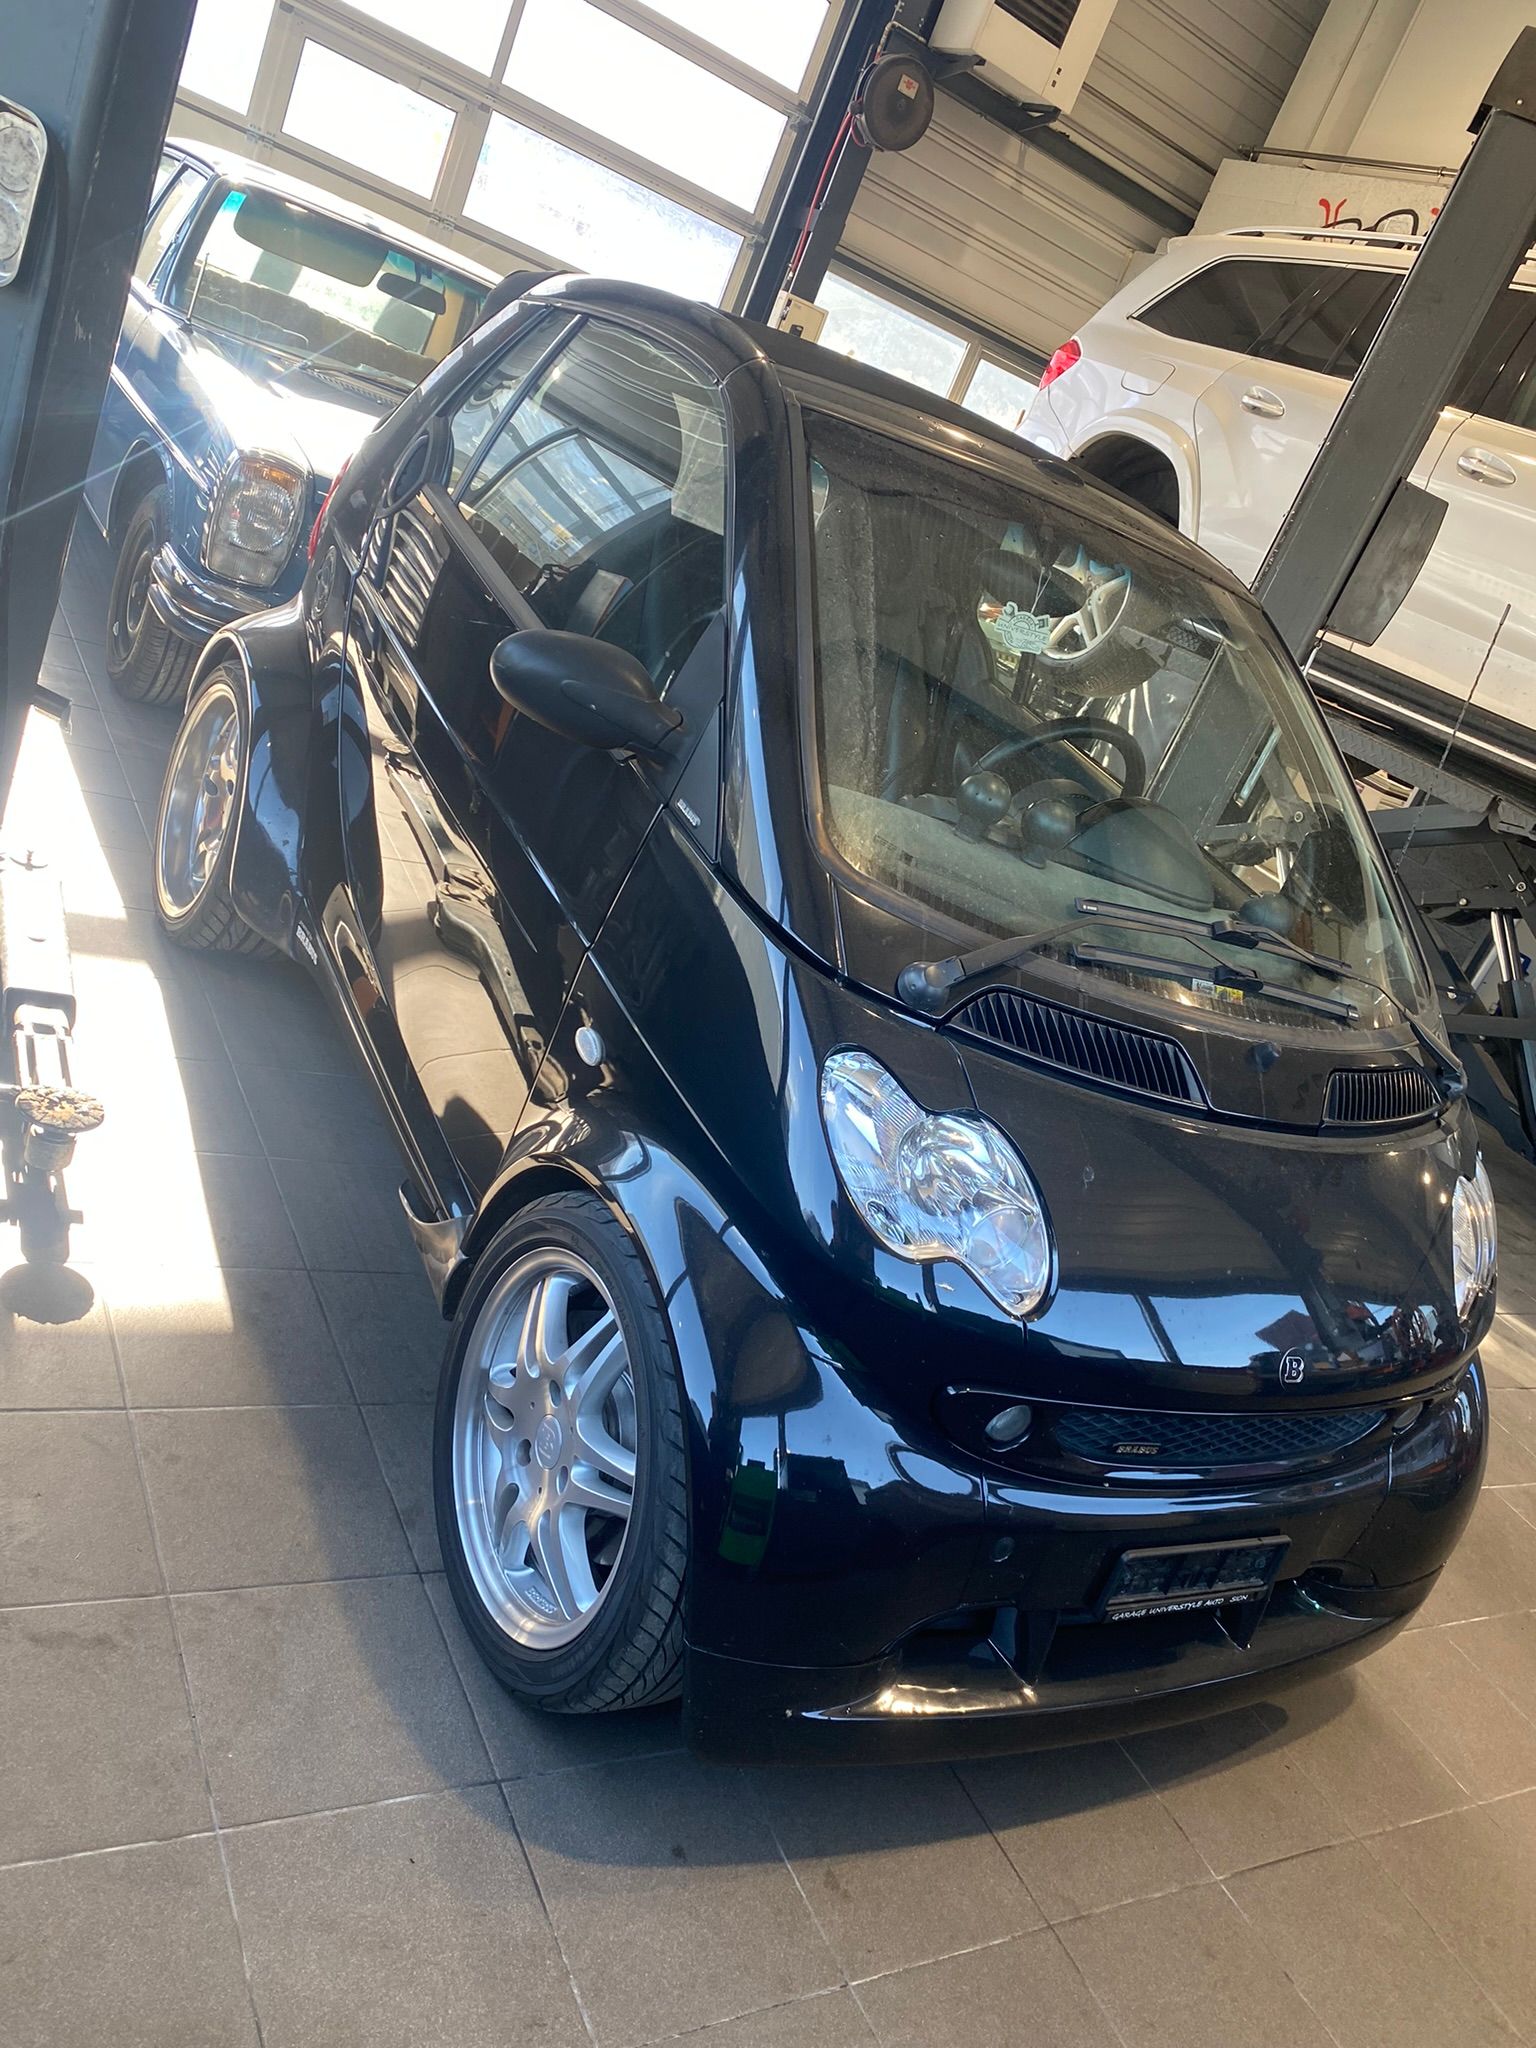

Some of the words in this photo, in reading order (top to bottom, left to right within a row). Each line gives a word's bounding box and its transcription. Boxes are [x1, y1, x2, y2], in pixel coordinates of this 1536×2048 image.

[1115, 1445, 1160, 1455] BRABUS
[1112, 1609, 1147, 1621] GARAGE
[1149, 1600, 1203, 1615] UNIVERSTYLE
[1203, 1598, 1225, 1607] AUTO
[1229, 1594, 1249, 1603] SION
